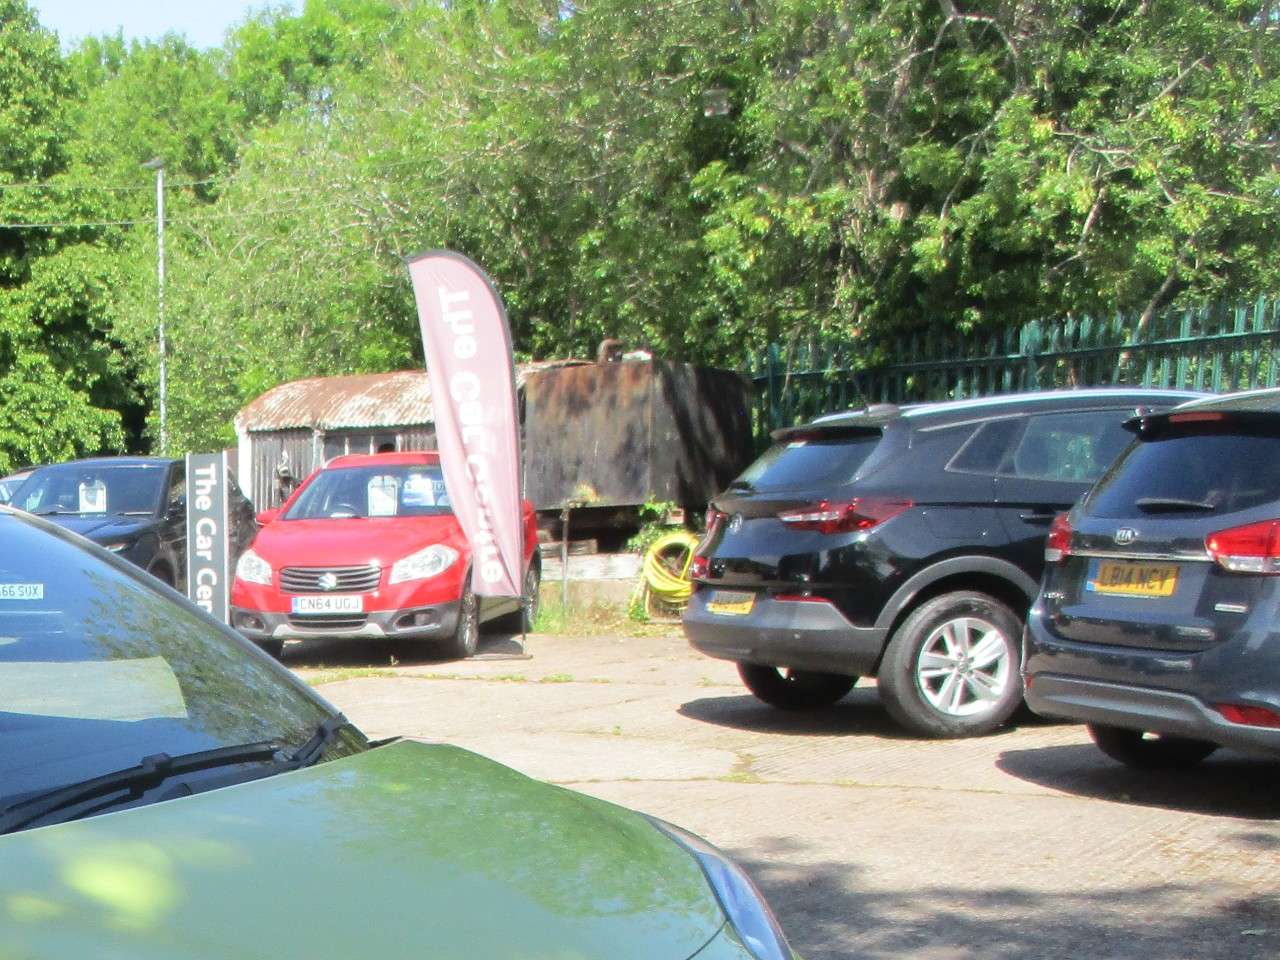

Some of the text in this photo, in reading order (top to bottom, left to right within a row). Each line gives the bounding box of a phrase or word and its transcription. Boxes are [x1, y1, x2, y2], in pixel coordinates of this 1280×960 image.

[194, 463, 217, 511] The
[195, 517, 217, 561] Car
[17, 585, 40, 597] SUX
[300, 598, 331, 610] CN64
